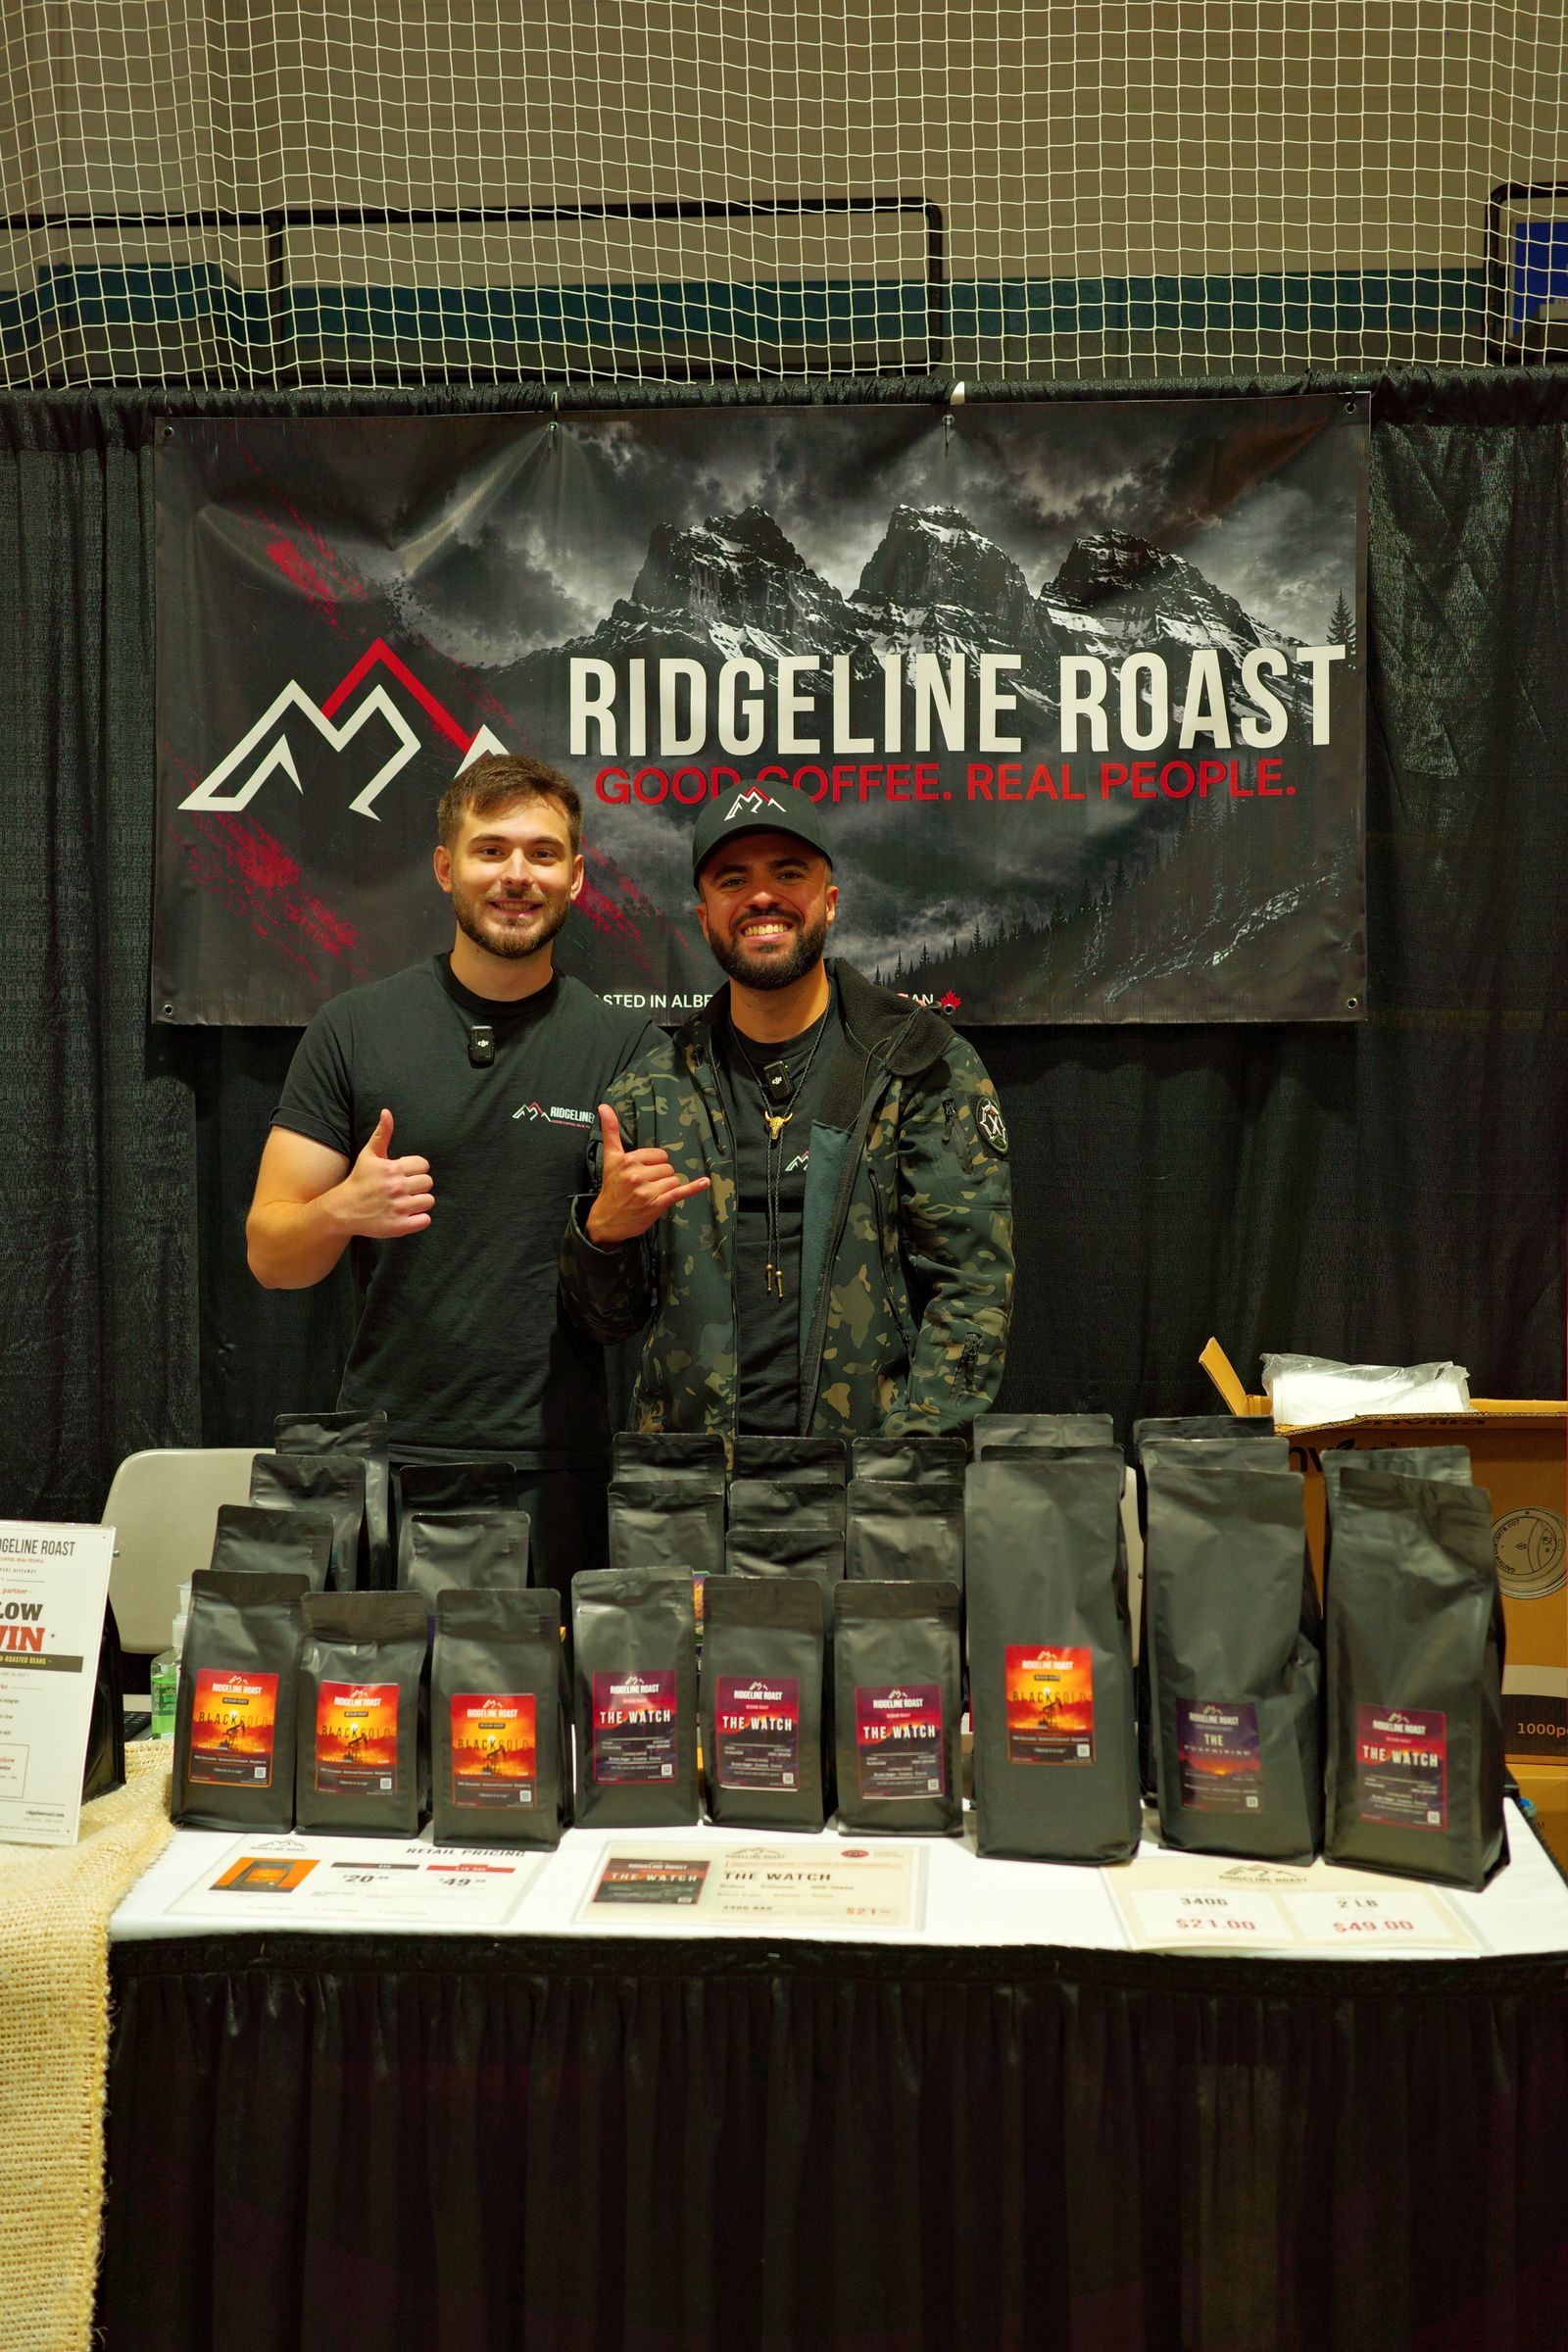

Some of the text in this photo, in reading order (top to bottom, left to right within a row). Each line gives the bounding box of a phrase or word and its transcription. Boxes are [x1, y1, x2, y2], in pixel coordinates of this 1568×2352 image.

[569, 644, 1347, 757] RIDGELINE ROAST
[595, 766, 741, 805] GOOD
[967, 763, 1086, 801] REAL
[1101, 759, 1297, 800] PEOPLE.
[595, 994, 646, 1008] STED
[650, 994, 666, 1008] IN
[0, 1538, 76, 1556] GELINE ROAST
[600, 1709, 670, 1724] THE WATCH
[722, 1716, 792, 1731] THE WATCH
[863, 1725, 936, 1740] THE WATCH
[1518, 1723, 1568, 1739] 1000p
[1203, 1734, 1224, 1746] THE
[1362, 1745, 1439, 1768] THE WATCH
[462, 1848, 526, 1857] PRICING
[1339, 1899, 1348, 1908] 2
[1176, 1918, 1255, 1931] $21.00
[1334, 1920, 1414, 1933] $49.00
